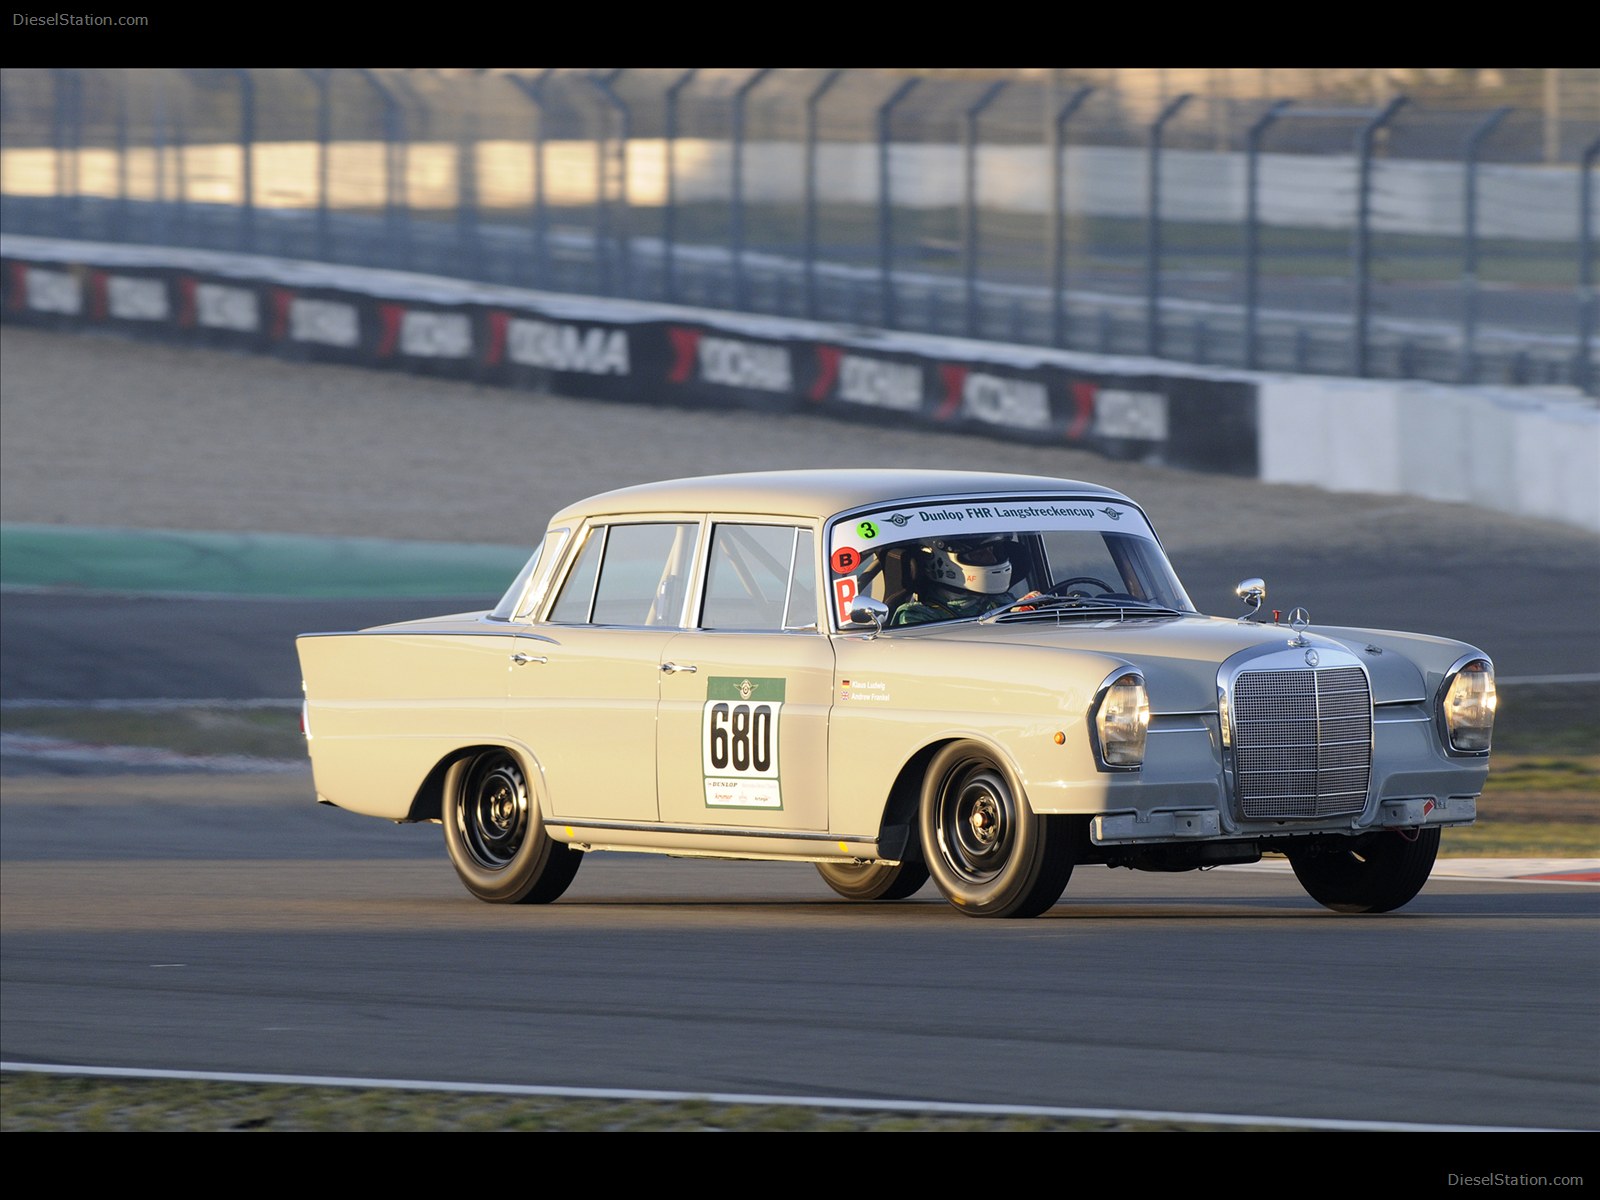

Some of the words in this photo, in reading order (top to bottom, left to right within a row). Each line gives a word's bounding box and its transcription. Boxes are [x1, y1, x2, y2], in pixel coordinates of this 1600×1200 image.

[918, 509, 964, 521] Dunlop
[966, 507, 993, 519] FHR
[994, 506, 1096, 519] Langstreckencup
[860, 521, 876, 539] 3
[839, 553, 853, 567] B
[711, 702, 771, 772] 680
